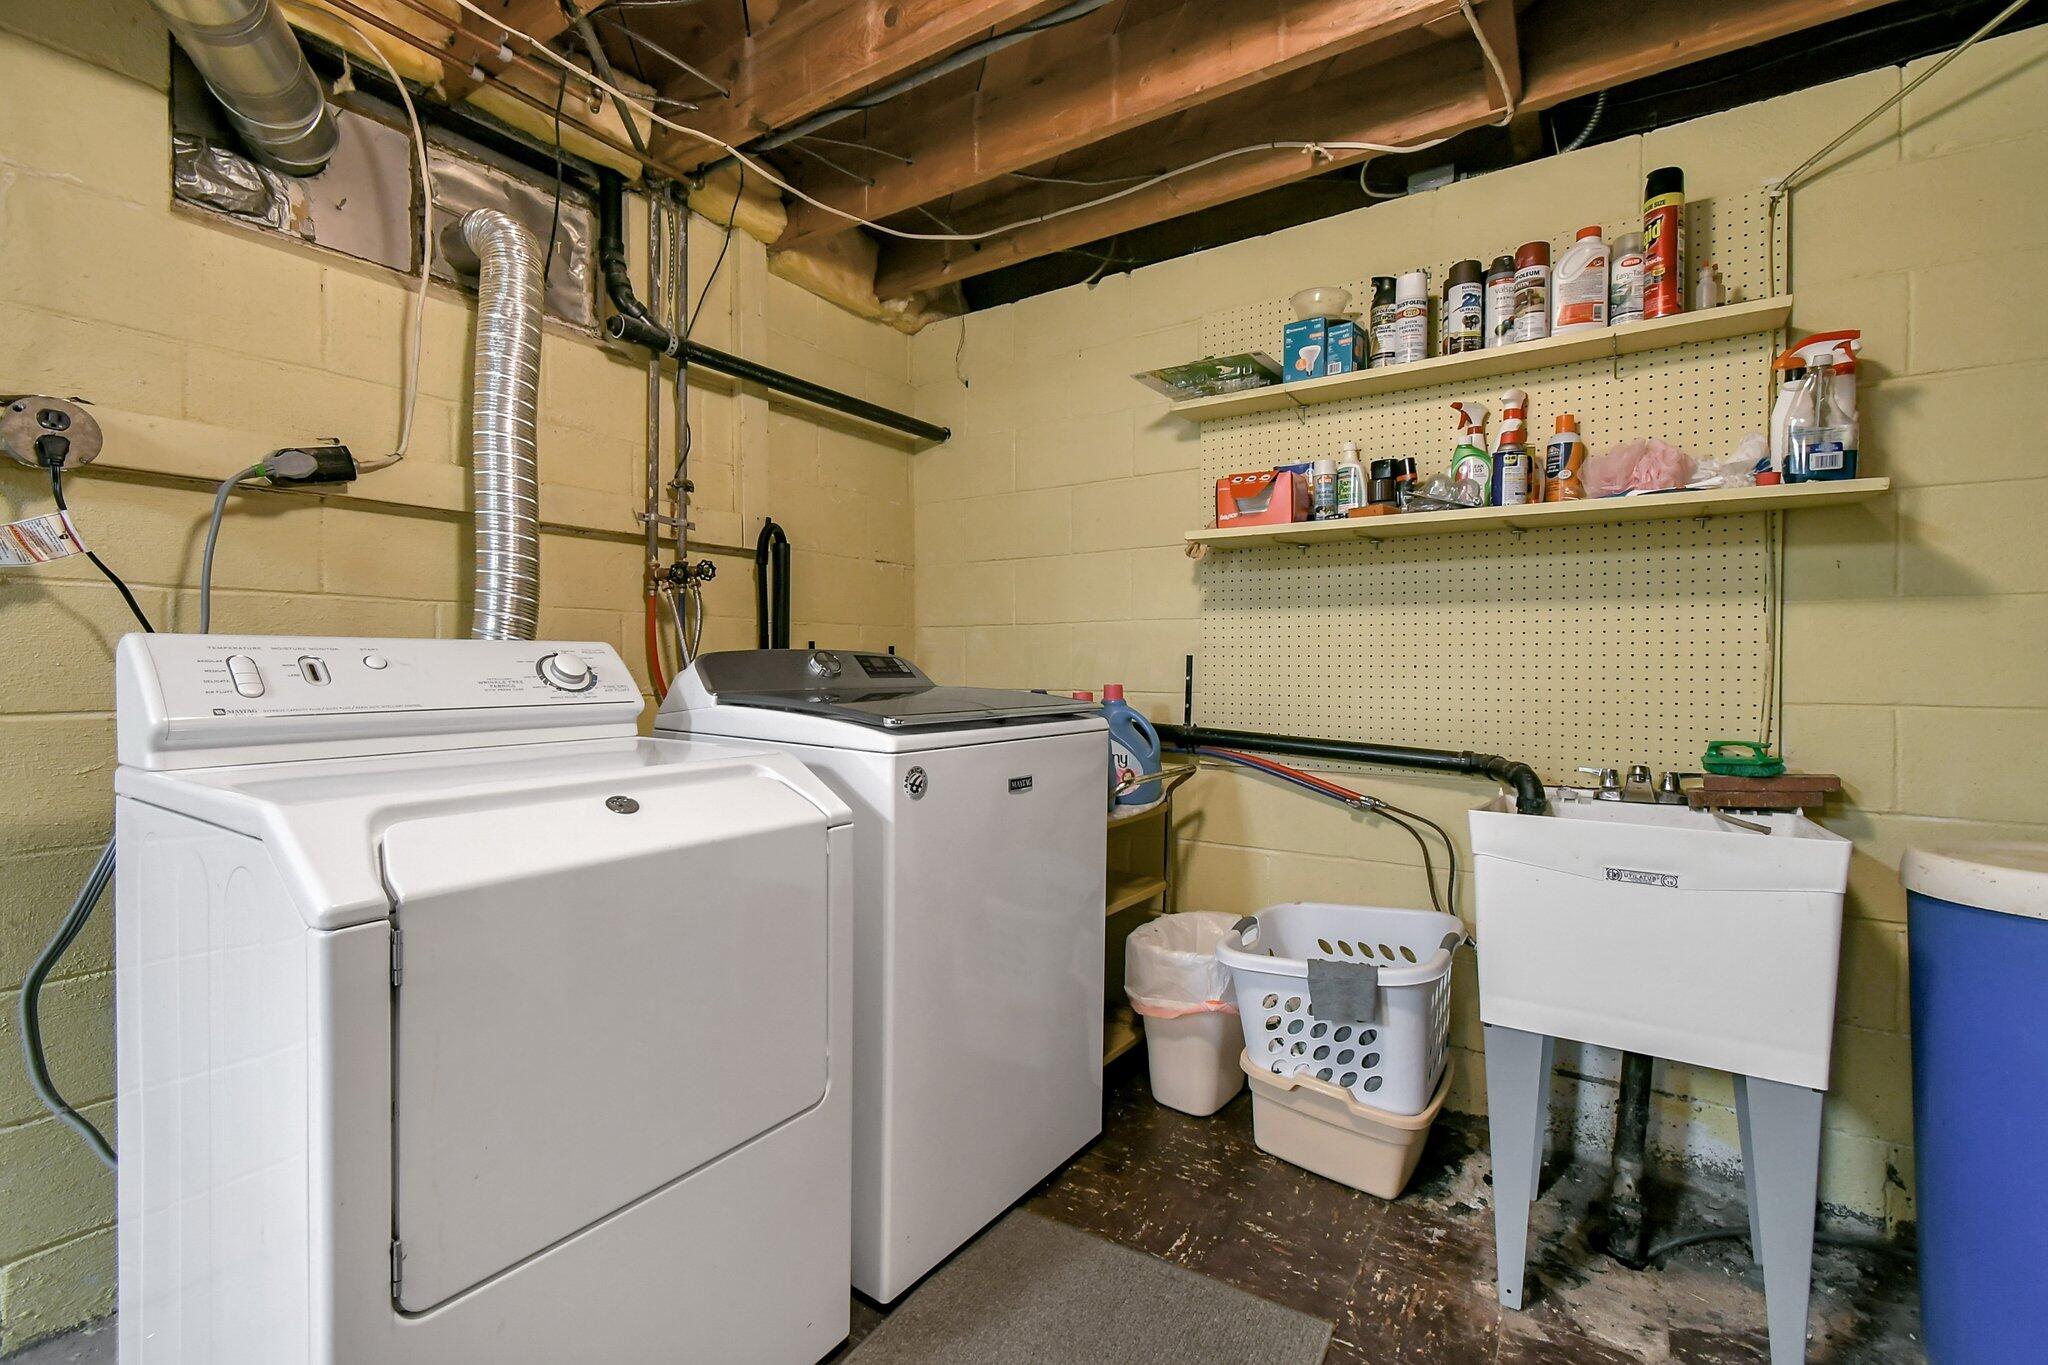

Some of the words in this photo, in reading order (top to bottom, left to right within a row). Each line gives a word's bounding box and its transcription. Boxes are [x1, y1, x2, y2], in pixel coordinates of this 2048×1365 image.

[1644, 219, 1661, 246] aid
[1616, 269, 1644, 280] Easy-Tac
[1111, 753, 1128, 768] ny
[1011, 778, 1032, 789] MAYTAG
